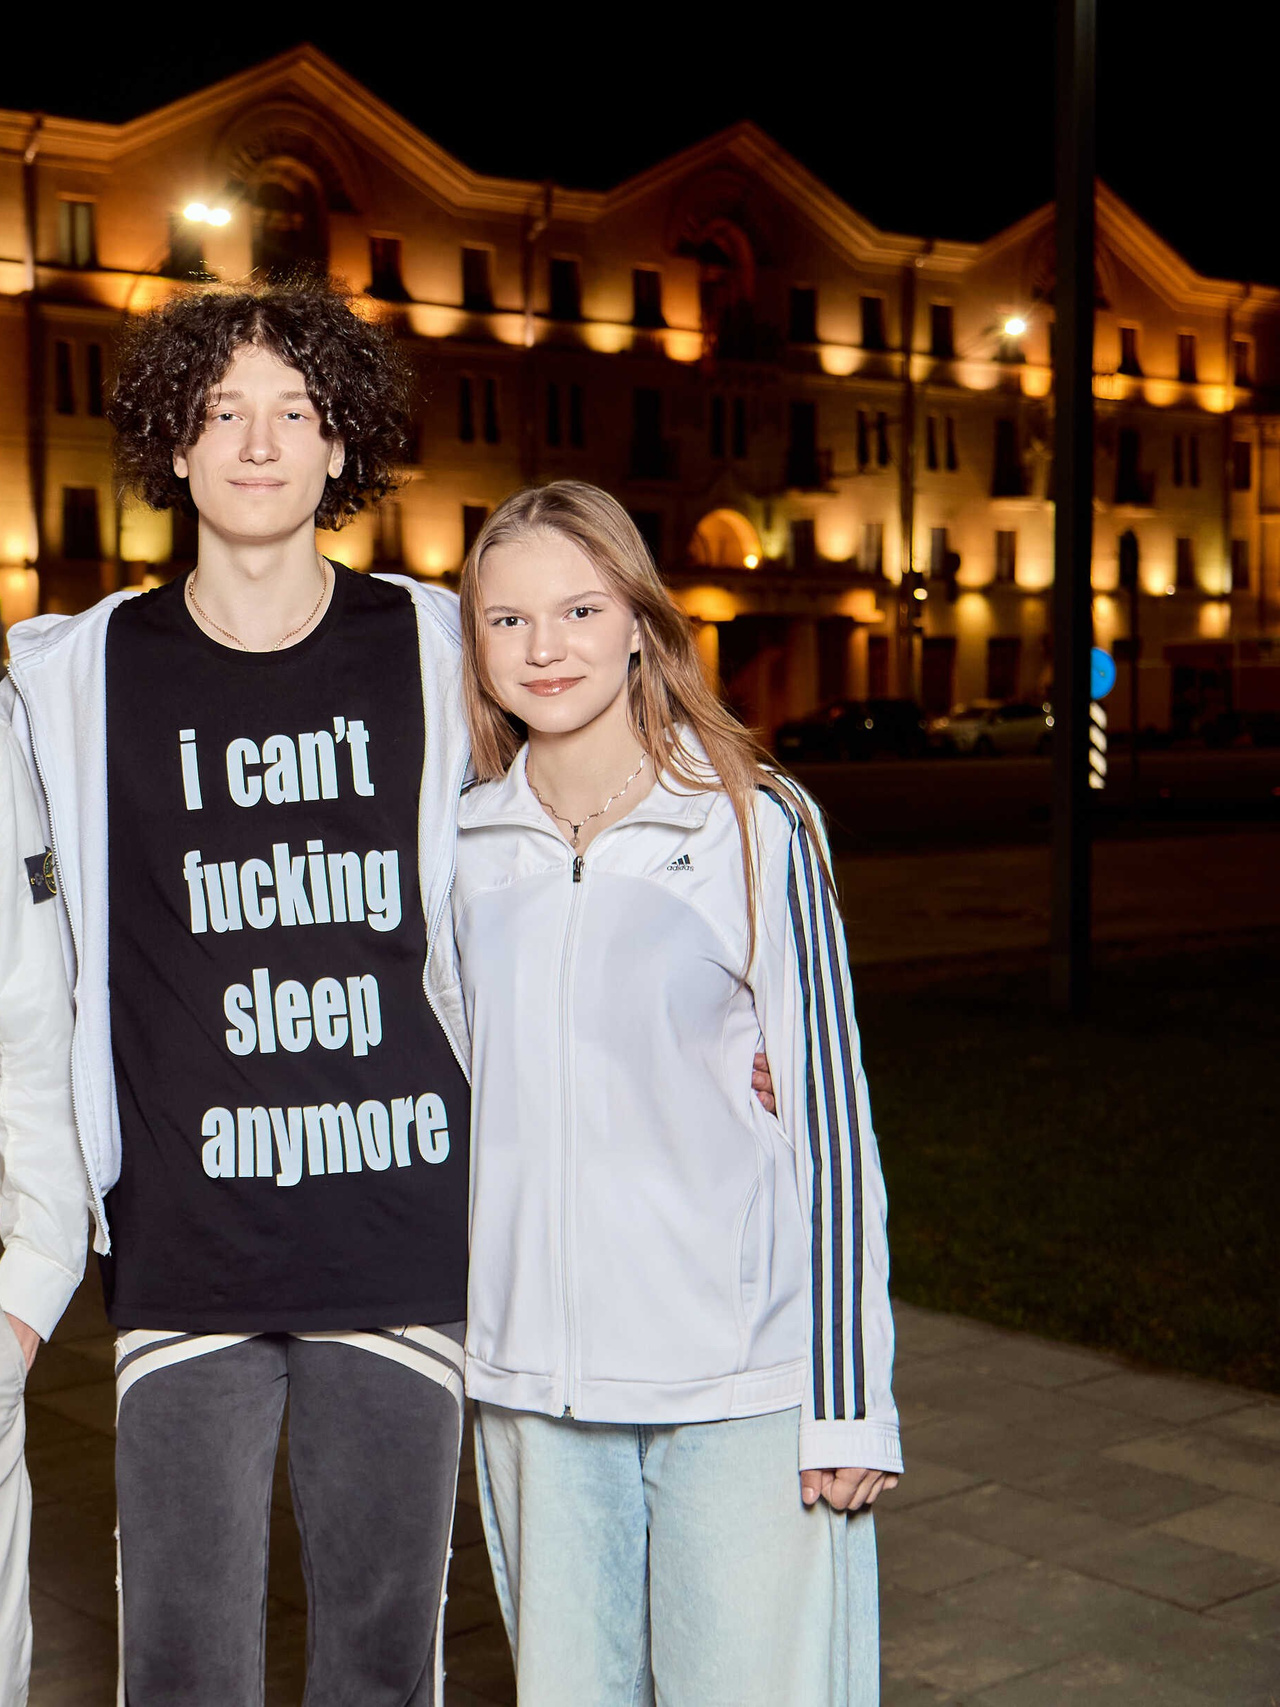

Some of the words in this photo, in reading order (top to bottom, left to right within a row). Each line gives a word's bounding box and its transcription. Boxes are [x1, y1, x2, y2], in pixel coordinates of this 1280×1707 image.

[179, 728, 203, 811] i
[225, 716, 375, 808] can't
[183, 839, 402, 934] fucking
[223, 967, 383, 1057] sleep
[201, 1092, 450, 1187] anymore
